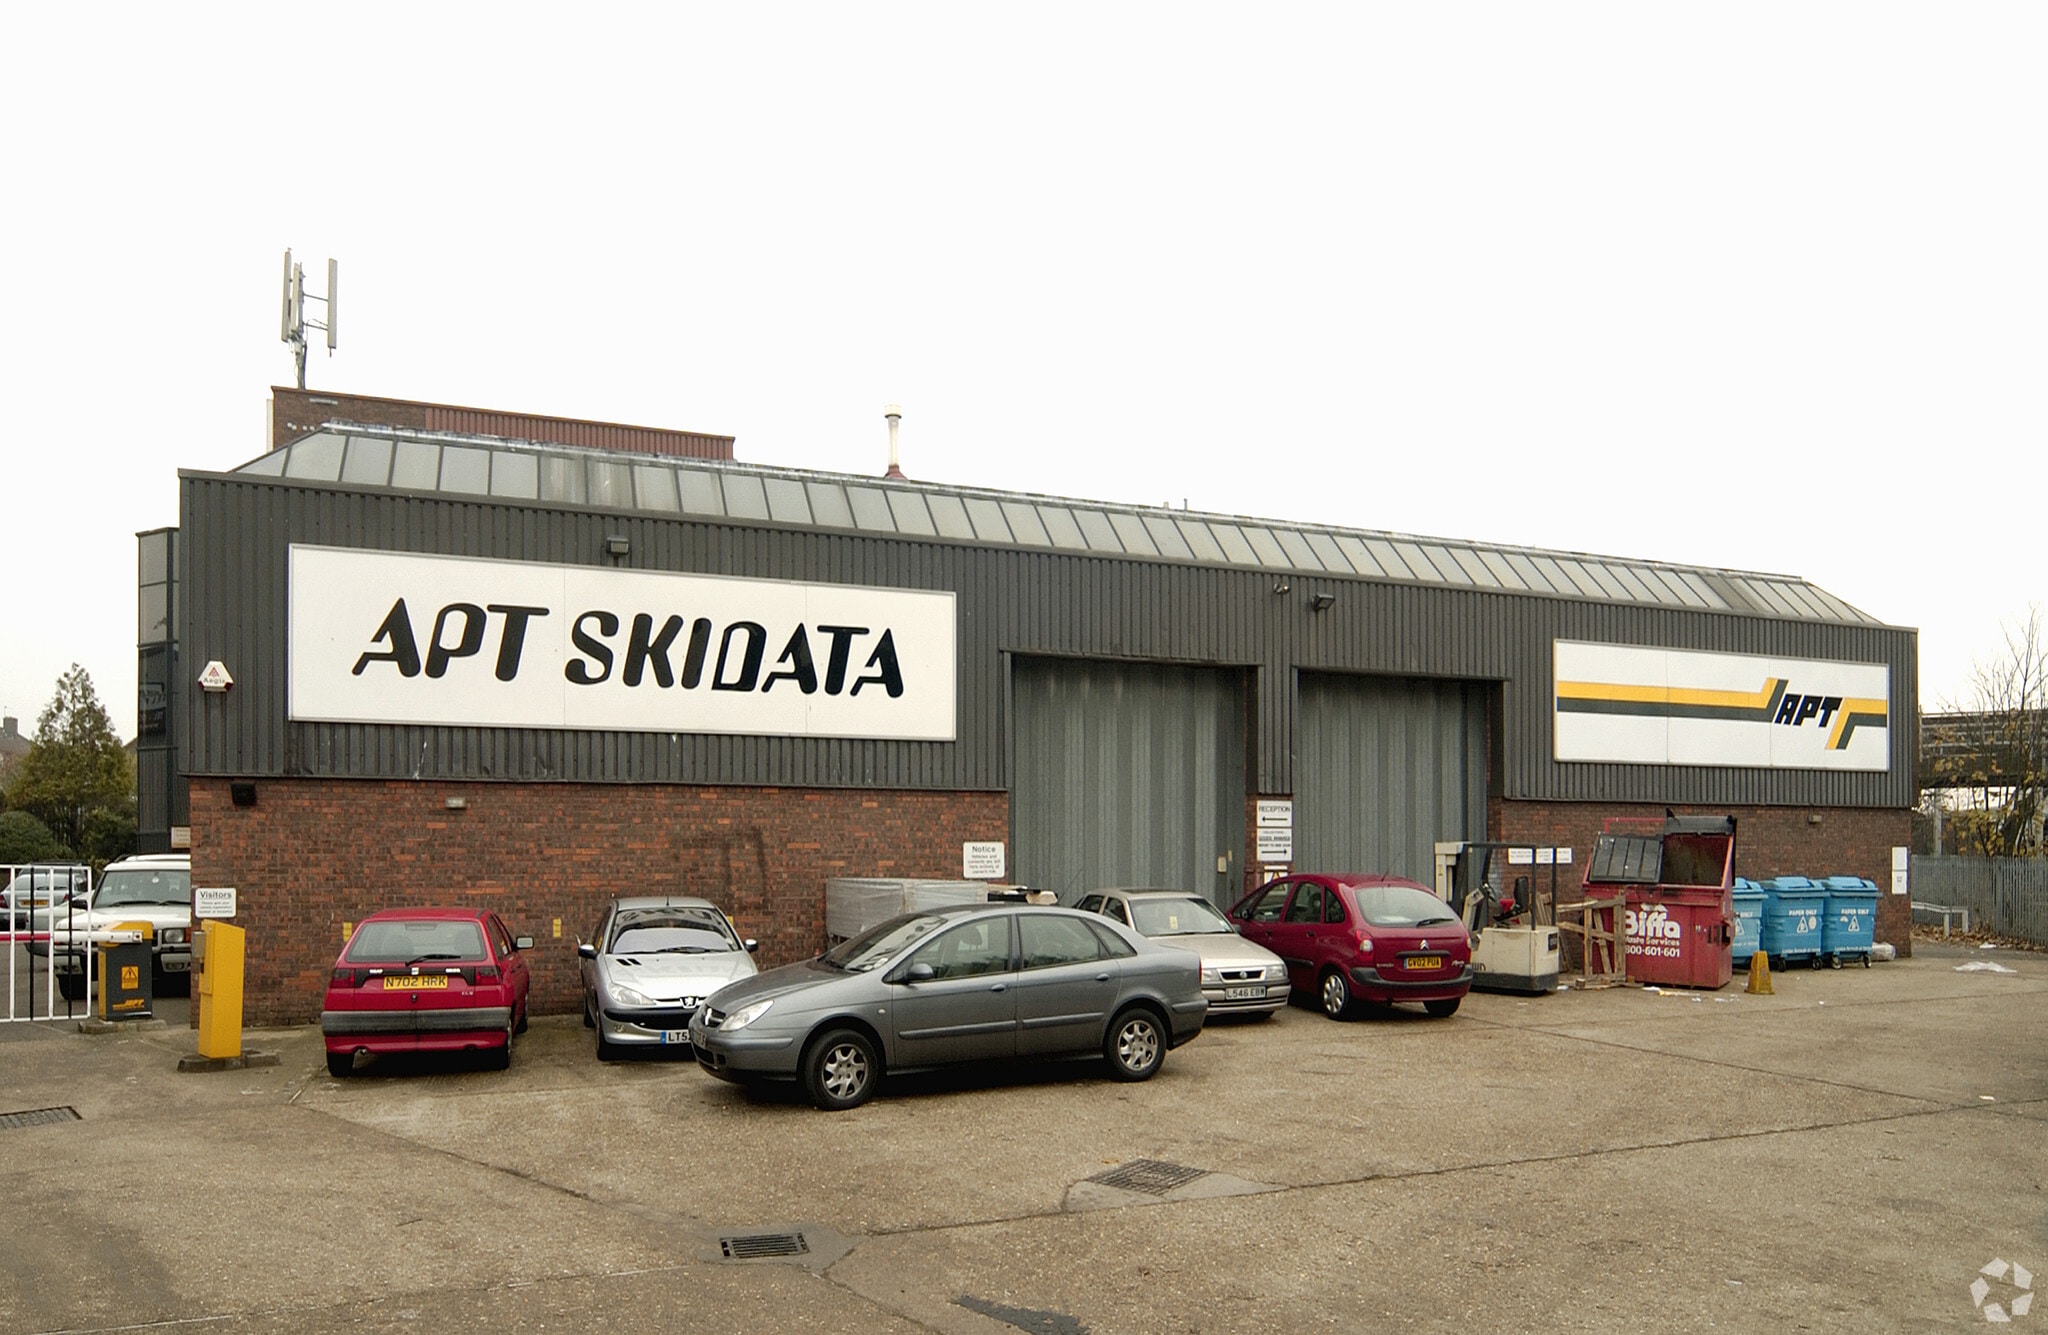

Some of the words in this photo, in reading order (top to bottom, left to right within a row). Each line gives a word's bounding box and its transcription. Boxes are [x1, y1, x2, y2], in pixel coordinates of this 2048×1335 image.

[351, 597, 550, 682] APT
[564, 610, 904, 699] SKIDATA
[1774, 692, 1843, 728] APT
[972, 845, 996, 853] Notice
[1625, 909, 1680, 938] Biffa
[1625, 936, 1645, 945] aste
[1646, 936, 1680, 946] Services
[385, 977, 419, 987] N702
[421, 977, 448, 986] HRK
[1227, 988, 1249, 998] L546
[668, 1031, 691, 1042] LT5
